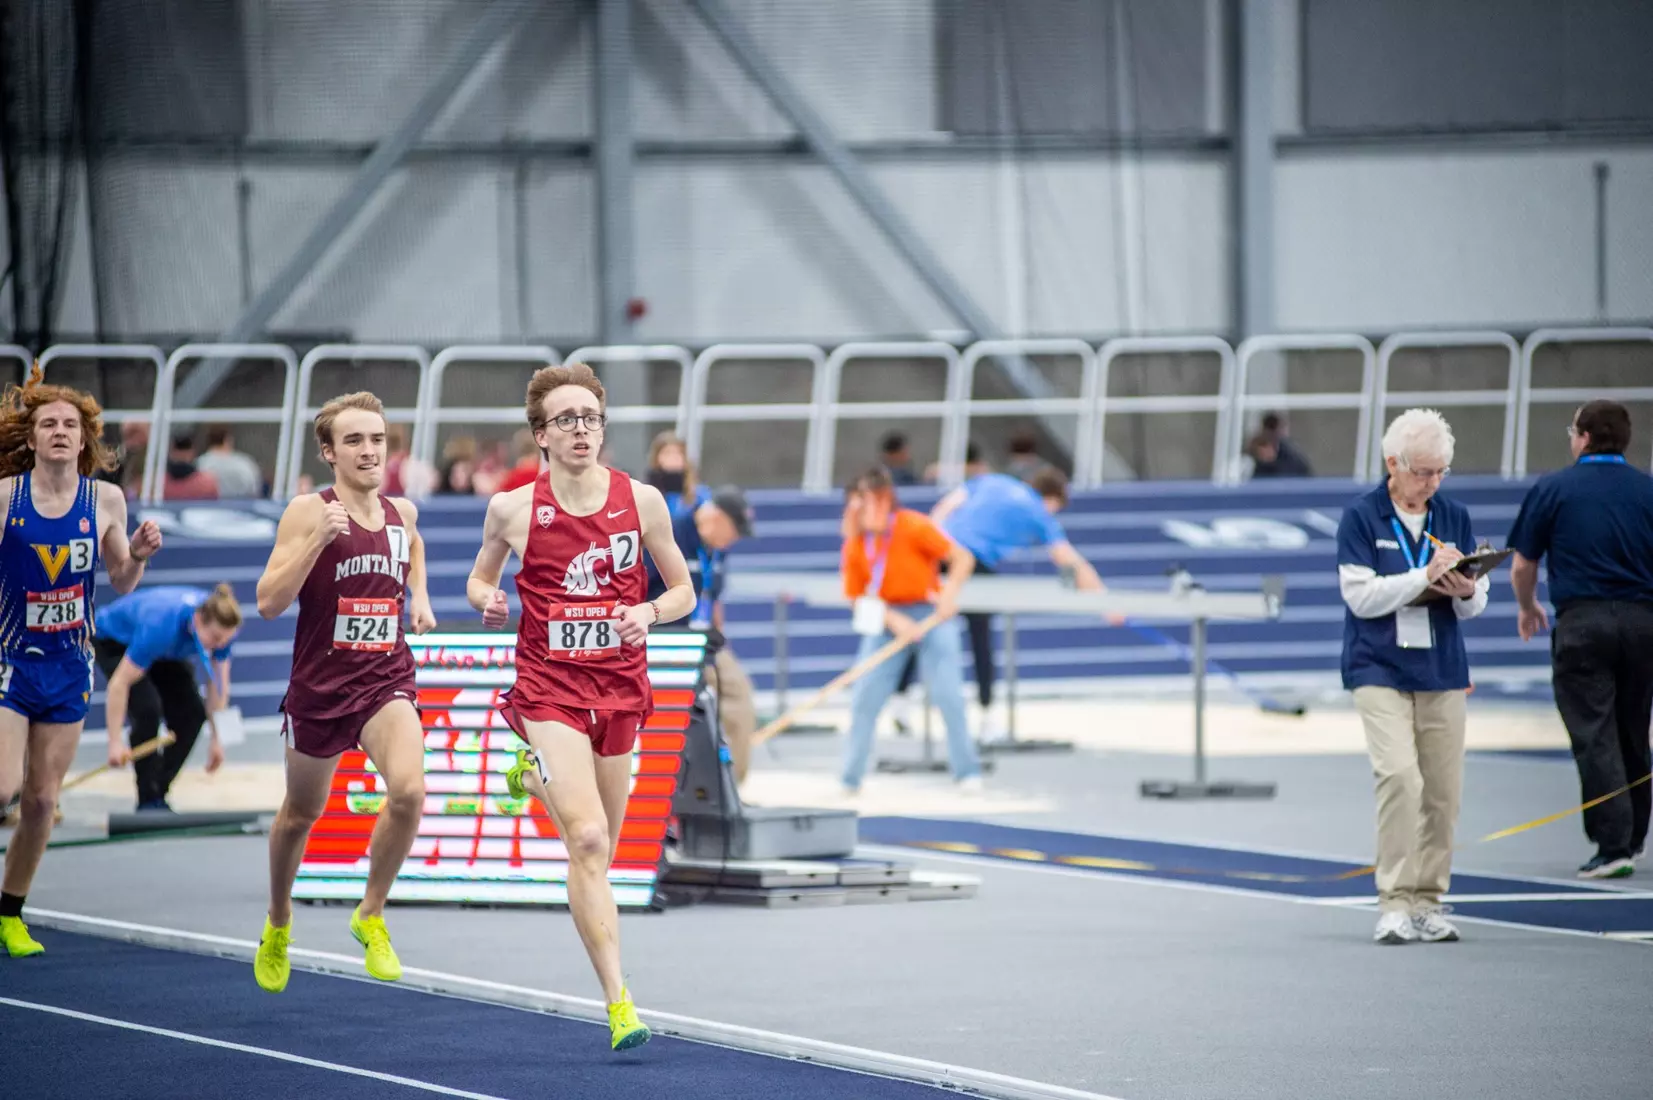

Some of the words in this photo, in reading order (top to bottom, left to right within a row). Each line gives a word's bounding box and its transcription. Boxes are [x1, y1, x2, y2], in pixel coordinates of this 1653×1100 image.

[75, 541, 89, 570] 3
[617, 535, 633, 569] 2
[40, 591, 57, 601] WSU
[59, 590, 75, 600] OPEN
[37, 602, 77, 625] 738
[353, 603, 370, 613] WSU
[372, 603, 389, 613] OPEN
[564, 608, 584, 618] WSU
[586, 607, 607, 617] OPEN
[345, 617, 389, 641] 524
[561, 621, 610, 649] 878
